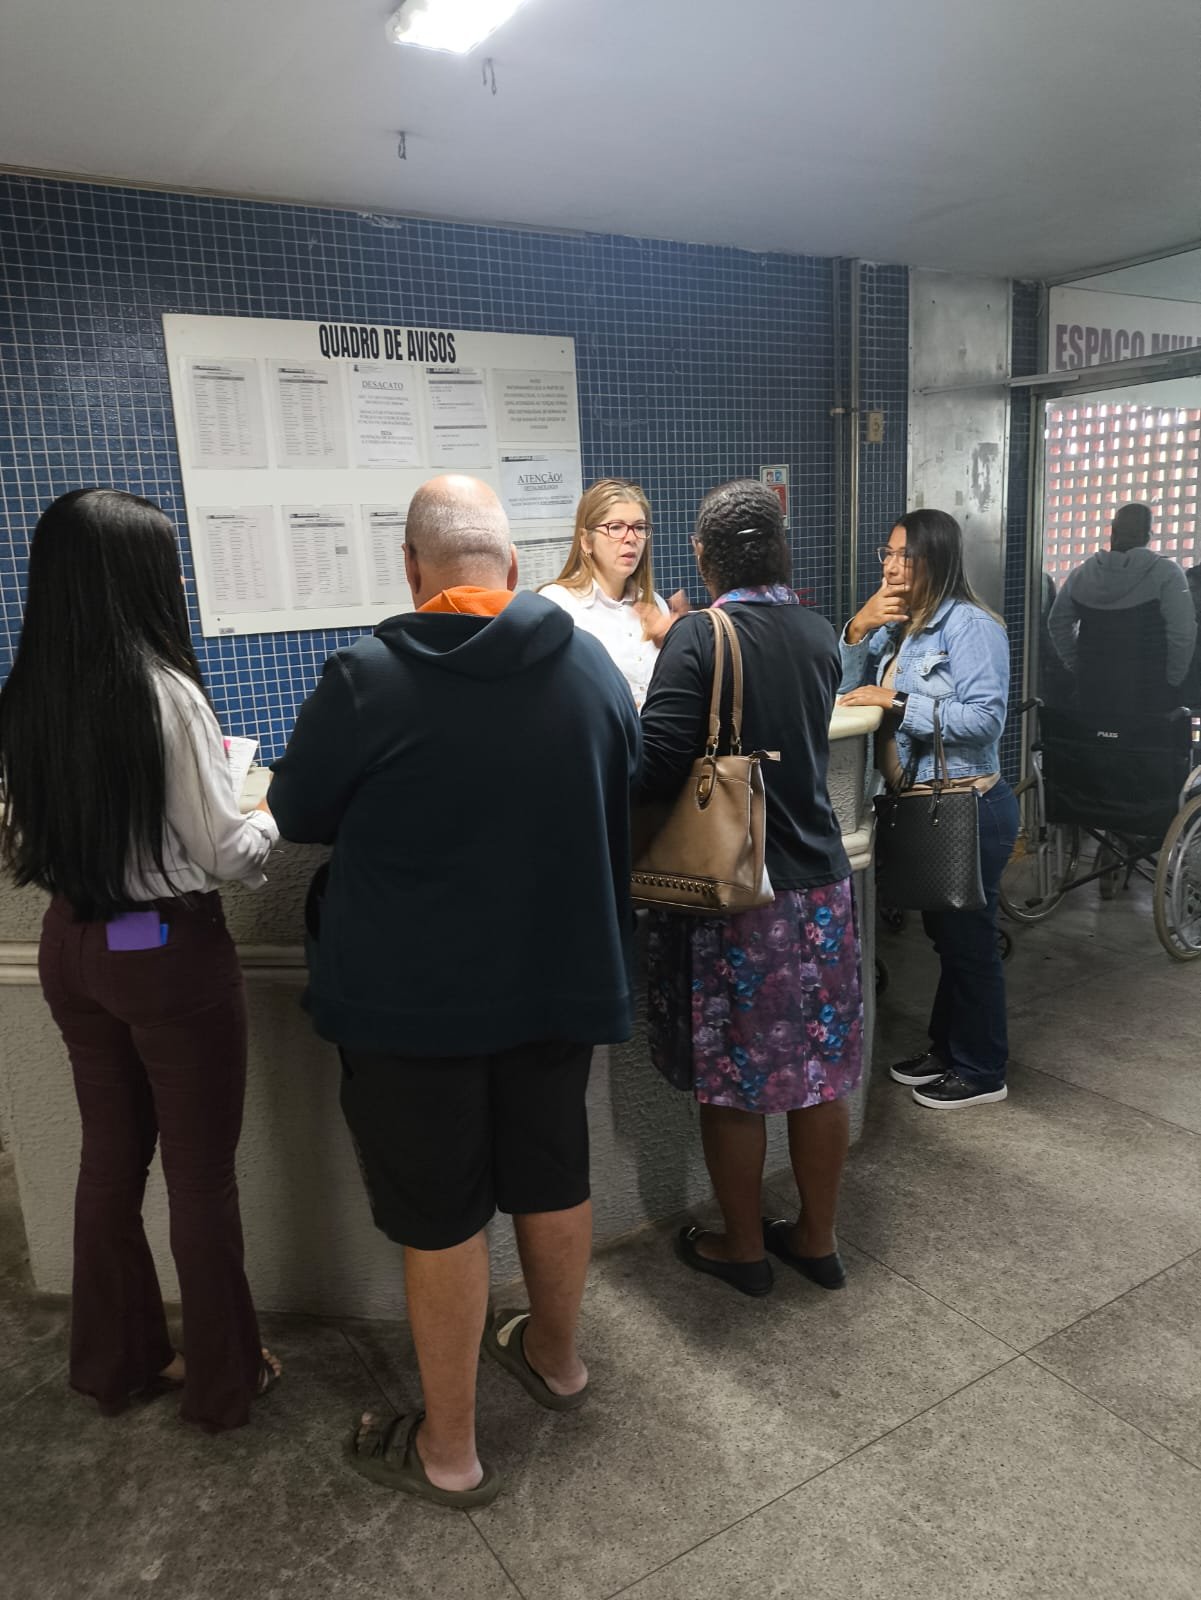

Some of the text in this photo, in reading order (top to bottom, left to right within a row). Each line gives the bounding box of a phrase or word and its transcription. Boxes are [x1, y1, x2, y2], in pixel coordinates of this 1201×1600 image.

[319, 324, 457, 363] QUADRO DE AVISOS
[361, 380, 404, 391] DESACATO
[517, 471, 564, 485] ATENÇÃO!
